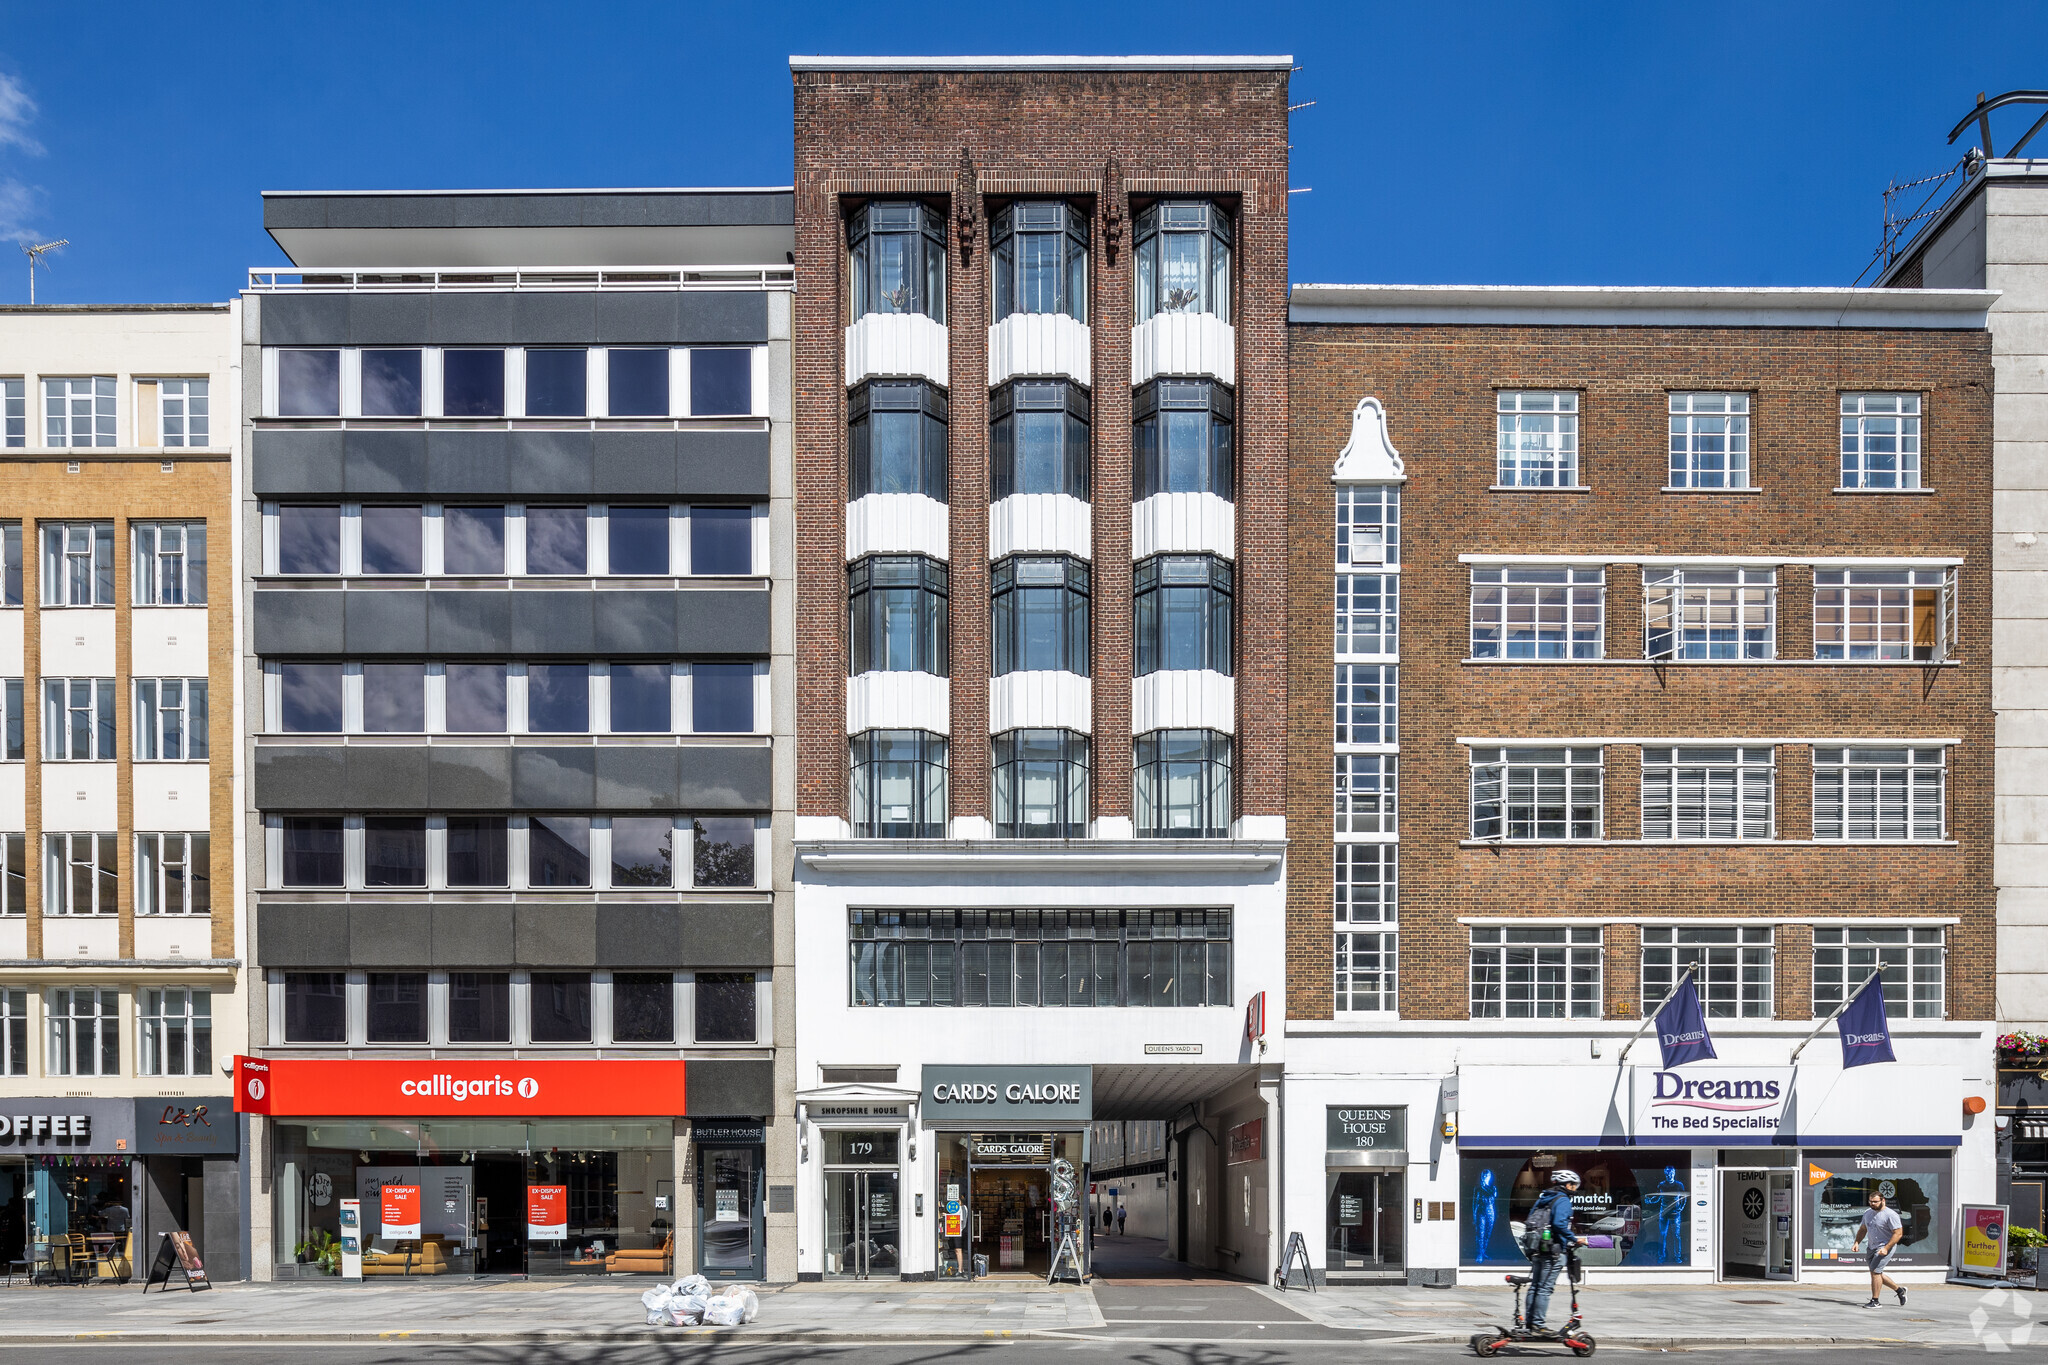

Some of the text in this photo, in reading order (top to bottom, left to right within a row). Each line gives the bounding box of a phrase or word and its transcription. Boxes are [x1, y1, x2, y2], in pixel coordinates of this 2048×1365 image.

[1662, 1030, 1705, 1046] Dreams
[1845, 1032, 1886, 1046] Dreams
[243, 1062, 269, 1072] calligaris
[400, 1074, 514, 1102] calligaris
[1652, 1072, 1781, 1100] Dreams
[933, 1083, 1081, 1102] CARDS GALORE
[1443, 1090, 1459, 1099] Dreams
[159, 1105, 212, 1127] L&R
[821, 1107, 898, 1115] SHROPSHIRE HOUSE
[1338, 1109, 1391, 1122] QUEENS
[1343, 1122, 1387, 1134] HOUSE
[1652, 1116, 1780, 1131] The Bed Specialist
[696, 1128, 762, 1136] BUTLER HOUSE
[1355, 1136, 1374, 1147] 180
[849, 1142, 873, 1155] 179
[977, 1144, 1044, 1153] CARDS GALORE
[1736, 1171, 1767, 1181] TEMPU
[1570, 1193, 1613, 1204] match
[1967, 1241, 1996, 1250] Further
